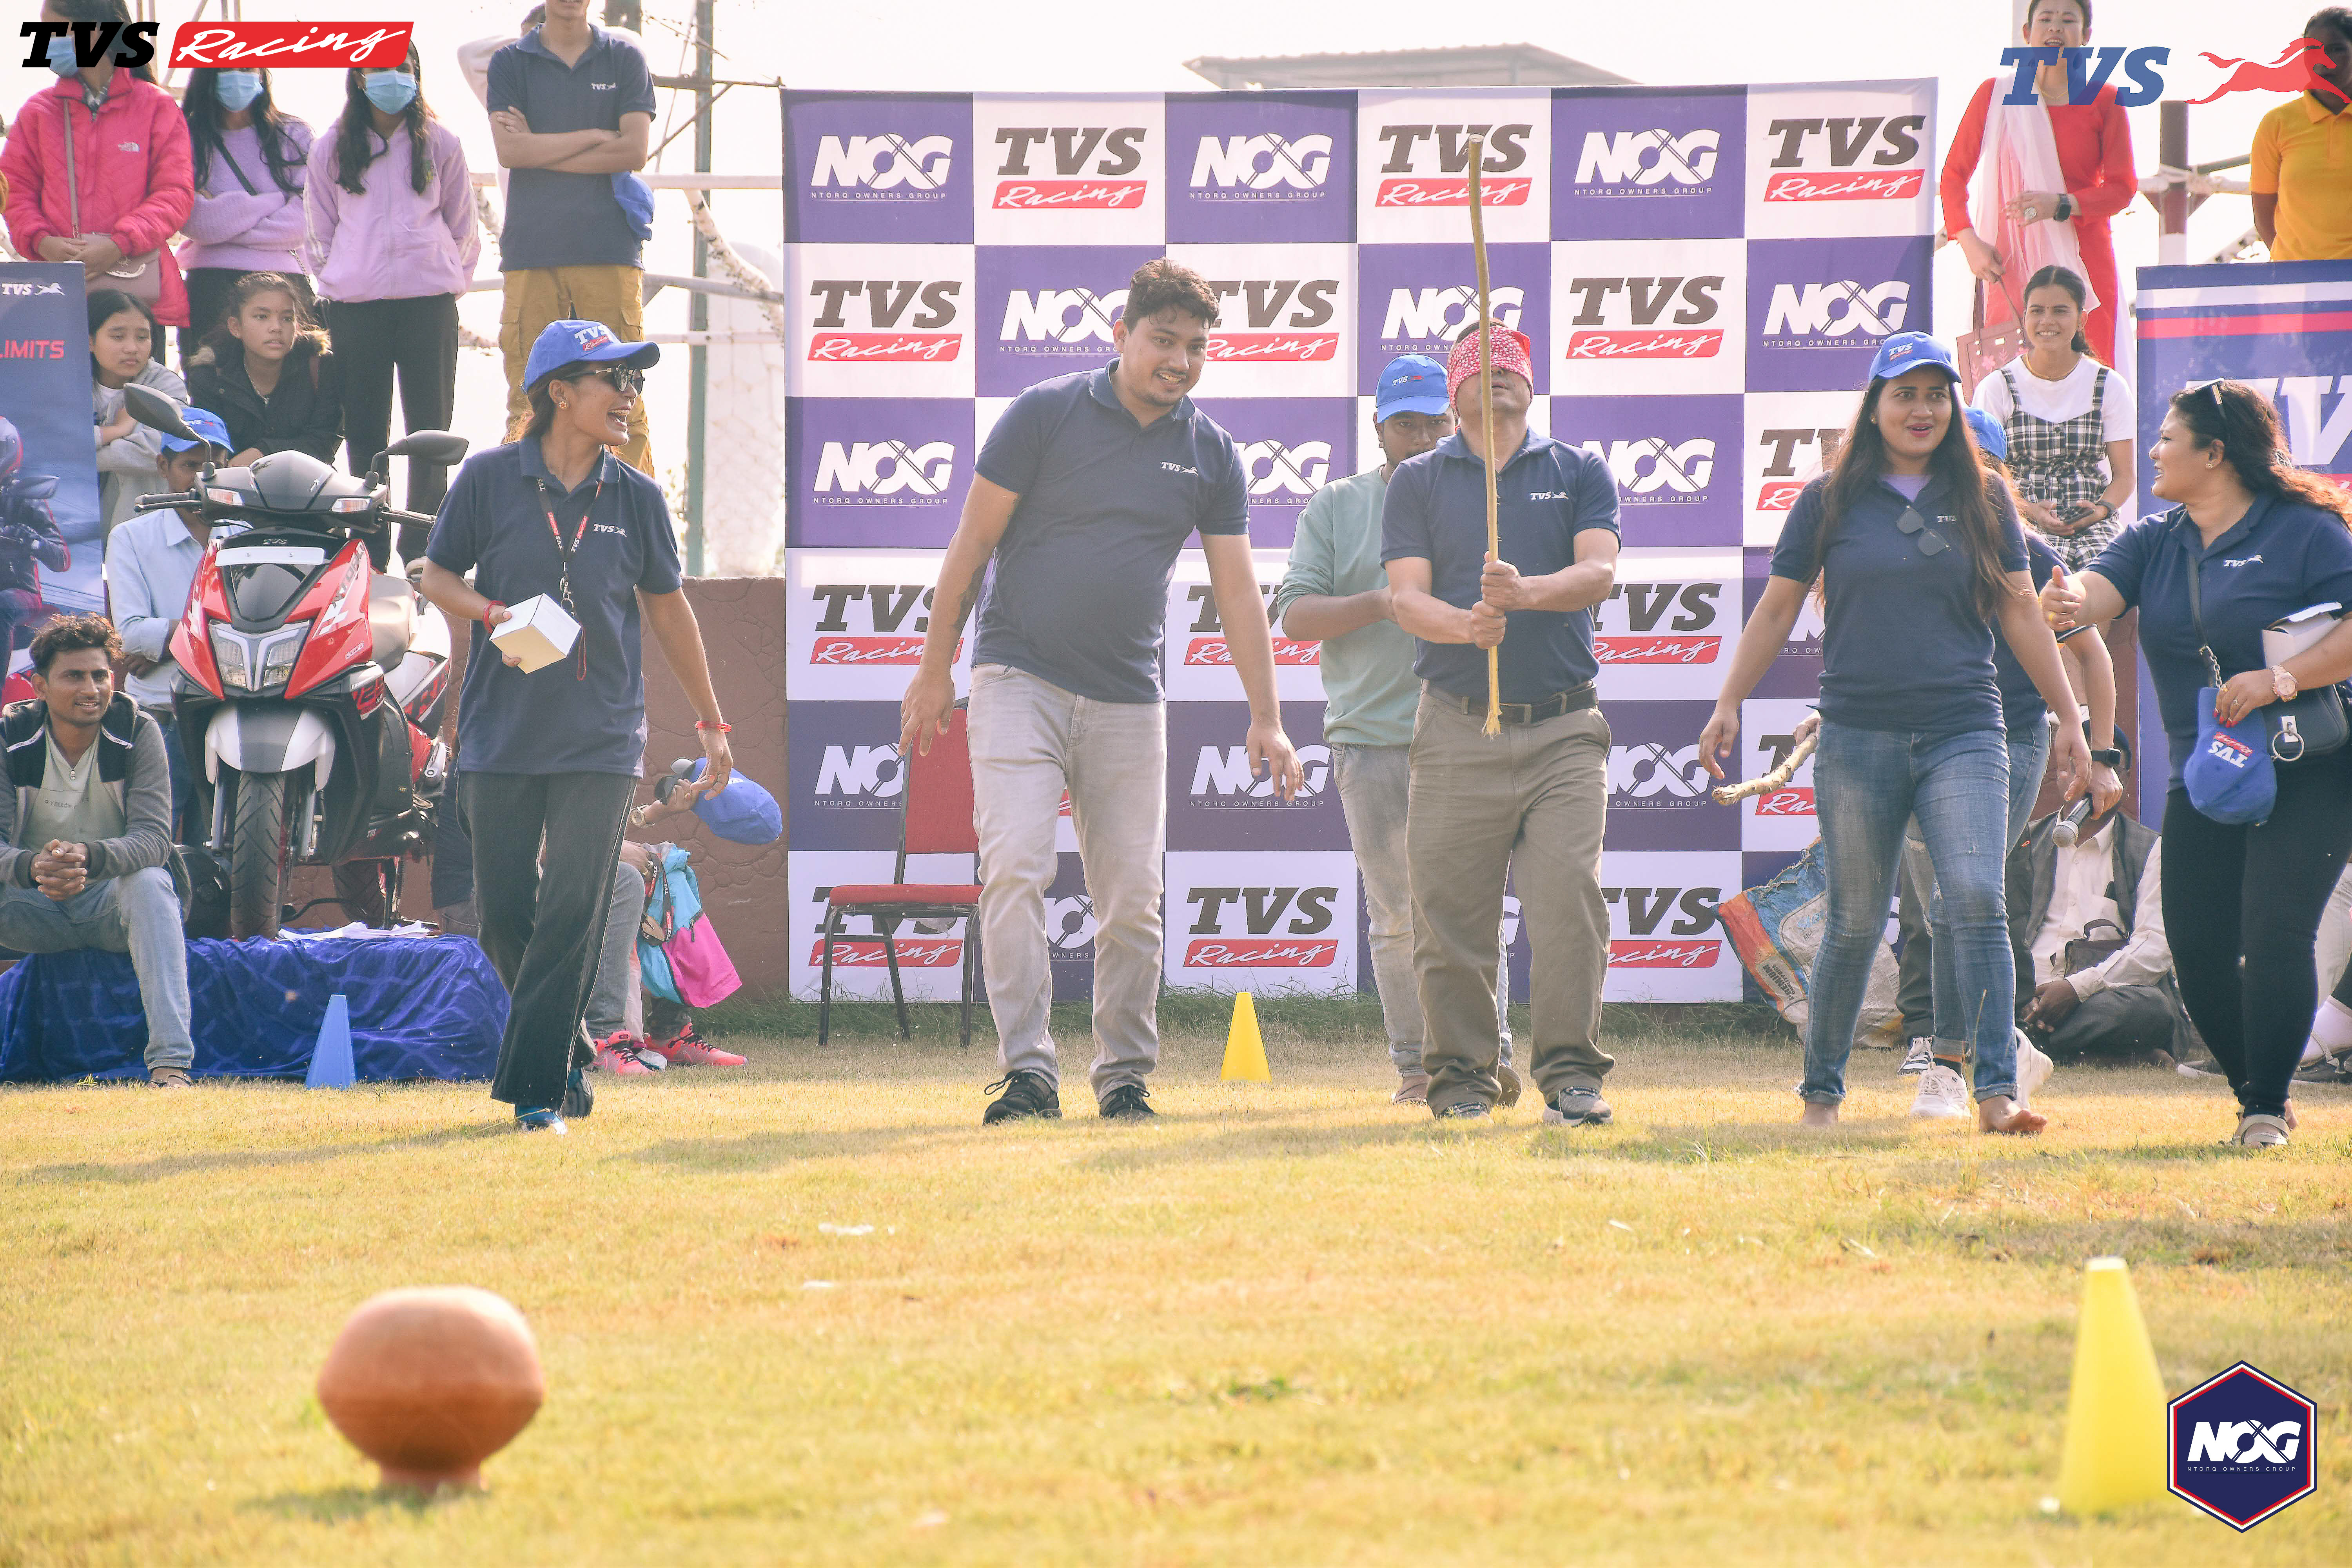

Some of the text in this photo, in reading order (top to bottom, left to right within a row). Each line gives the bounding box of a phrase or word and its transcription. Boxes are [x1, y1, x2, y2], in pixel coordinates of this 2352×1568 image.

[995, 127, 1147, 175] TVS
[1379, 124, 1533, 173] TVS
[1574, 128, 1721, 185] NOG
[1768, 115, 1926, 168] TVS
[811, 133, 953, 189] NOG
[1189, 133, 1332, 189] NOG
[997, 183, 1143, 207] Racing
[1770, 173, 1920, 200] Racing
[2, 283, 32, 295] TVS
[810, 280, 962, 328] TVS
[1570, 276, 1724, 325] TVS
[1762, 280, 1910, 336] NOG
[574, 326, 610, 345] TVS
[813, 336, 959, 359] Racing
[1572, 333, 1720, 358] Racing
[1889, 343, 1913, 356] TVS
[1393, 376, 1408, 386] TVS
[813, 439, 955, 495] NOG
[1161, 462, 1181, 472] TVS
[1235, 439, 1332, 495] OG
[1530, 491, 1551, 500] TVS
[593, 524, 615, 533] TVS
[816, 642, 924, 664] Racin
[814, 743, 905, 798] NO
[2207, 741, 2248, 768] TVS
[1187, 887, 1339, 935] TVS
[1599, 887, 1723, 935] VS
[1189, 943, 1334, 965] Racing
[1762, 964, 1794, 1000] PREMIUM
